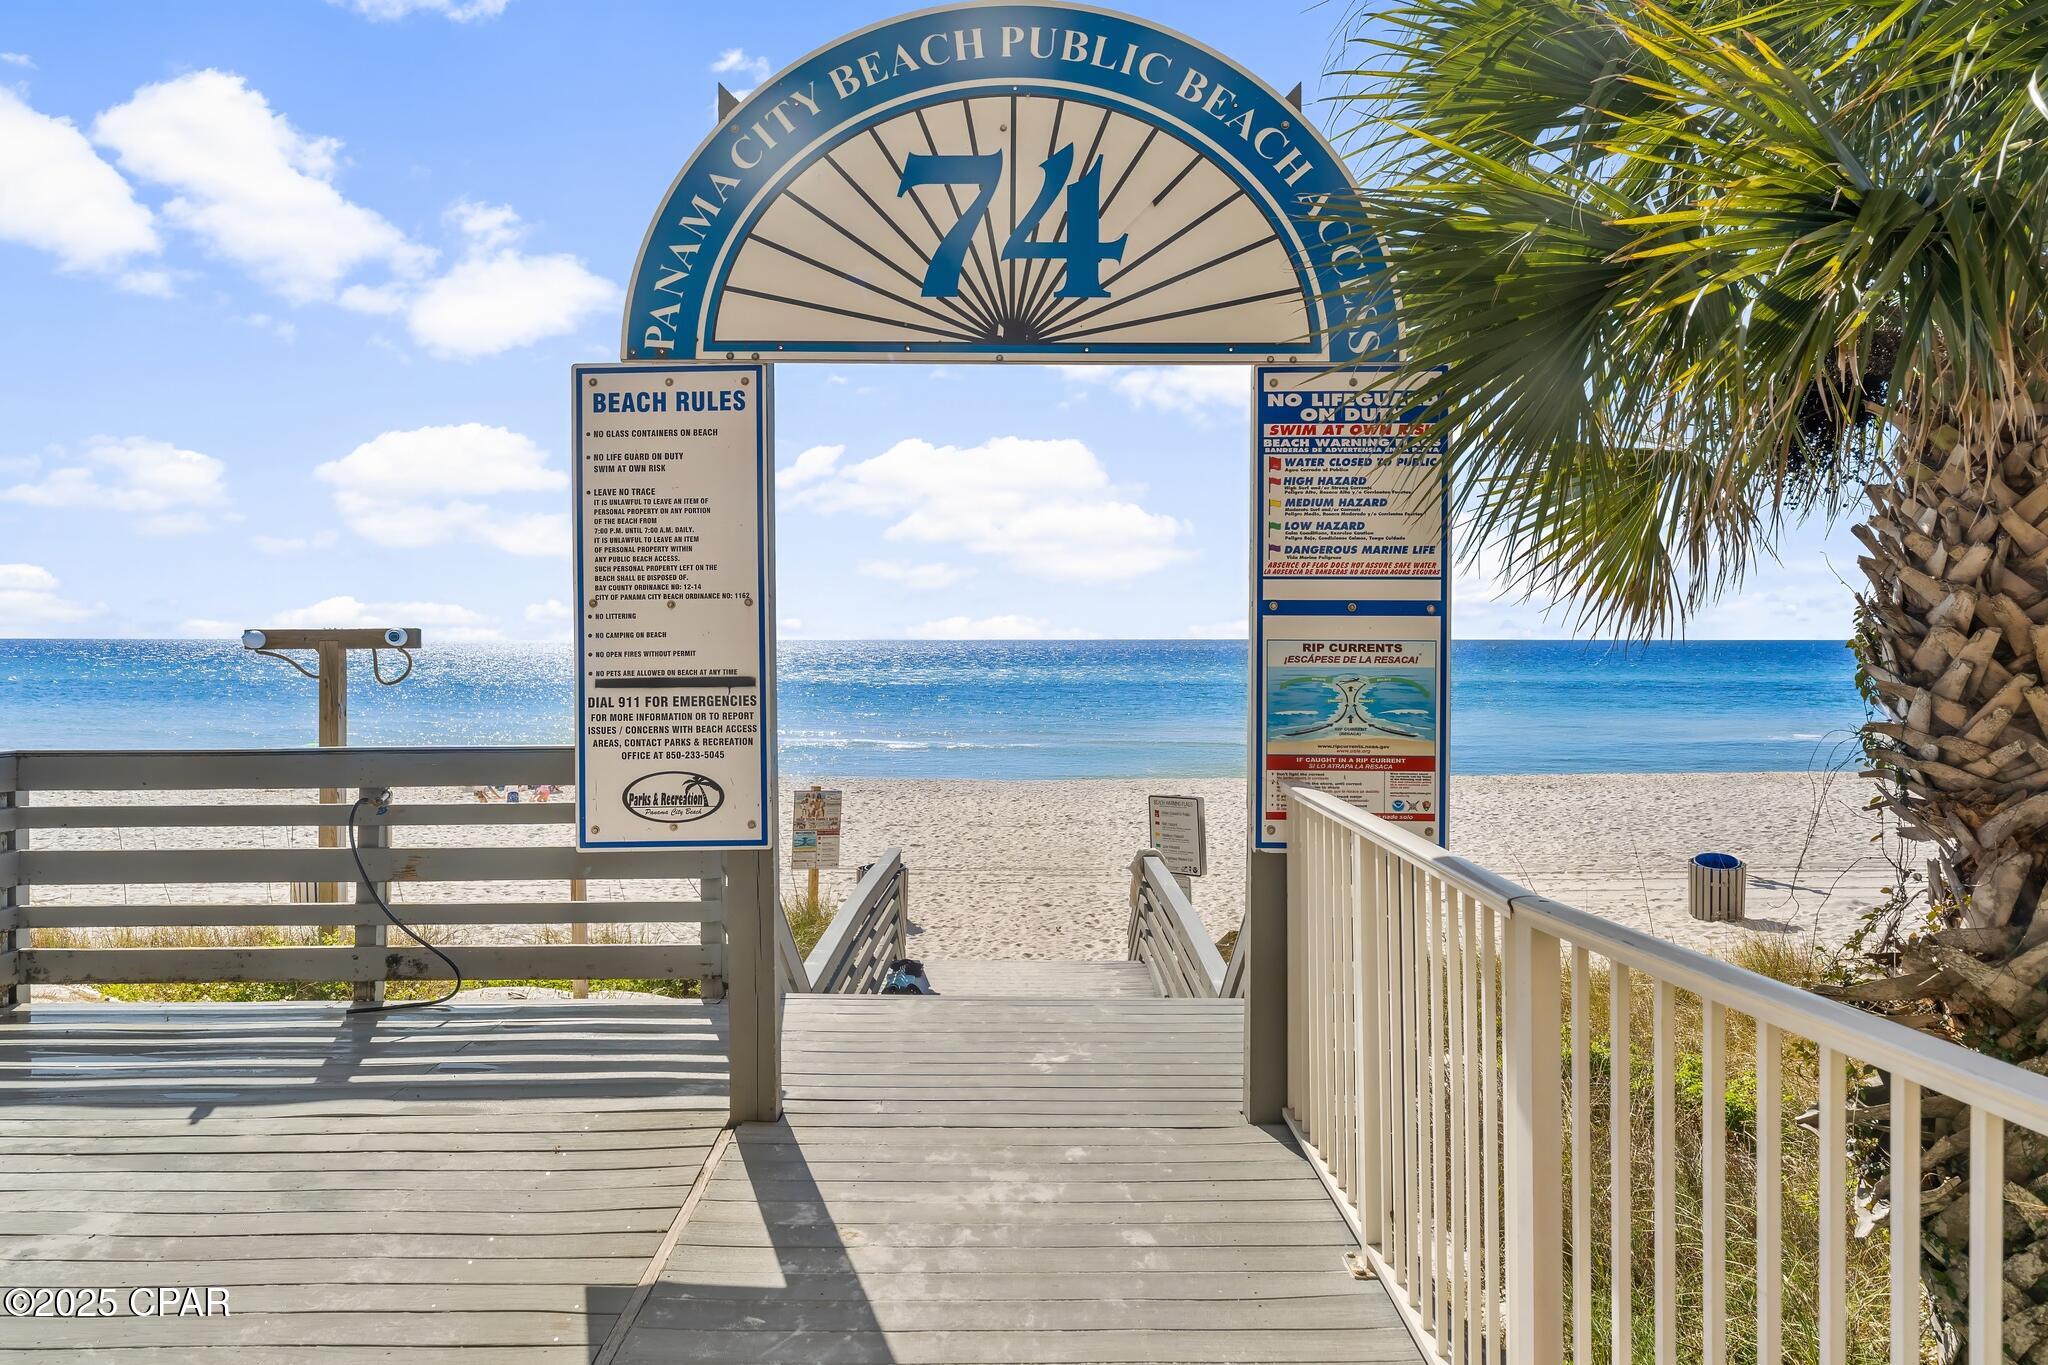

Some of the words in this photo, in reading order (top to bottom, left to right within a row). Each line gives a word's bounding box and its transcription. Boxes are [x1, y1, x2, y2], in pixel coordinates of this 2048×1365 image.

[644, 174, 741, 350] PANAMA
[731, 81, 822, 169] CITY
[828, 28, 985, 99] BEACH
[1000, 26, 1173, 85] PUBLIC
[1176, 67, 1314, 187] BEACH
[897, 142, 1129, 298] 74
[593, 392, 666, 412] BEACH
[676, 390, 745, 411] RULES
[1267, 393, 1302, 406] NO
[1300, 408, 1339, 421] ON
[1269, 425, 1317, 435] SWIM
[1323, 425, 1343, 434] AT
[1349, 425, 1391, 434] OWN
[1315, 439, 1390, 447] WARNING
[1285, 458, 1324, 466] WATER
[1329, 458, 1372, 466] CLOSED
[1396, 458, 1437, 466] PUBLIC
[1283, 477, 1313, 485] HIGH
[1317, 477, 1366, 485] HAZARD
[1284, 498, 1333, 506] MEDIUM
[1338, 498, 1387, 506] HAZARD
[1284, 522, 1312, 530] LOW
[1316, 522, 1364, 530] HAZARD
[1412, 546, 1435, 554] LIFE
[1303, 643, 1324, 652] RIP
[1329, 643, 1402, 652] CURRENTS
[1284, 654, 1340, 664] ¡ESCÁPESE
[588, 697, 614, 707] DIAL
[618, 696, 638, 707] 911
[645, 696, 667, 707] FOR
[673, 695, 756, 706] EMERGENCIES
[610, 713, 633, 721] MORE
[636, 713, 692, 721] INFORMATION
[588, 726, 616, 734] ISSUES
[619, 726, 622, 734] /
[625, 726, 668, 734] CONCERNS
[593, 739, 621, 747] AREAS,
[664, 738, 690, 746] PARKS
[622, 751, 650, 759] OFFICE
[666, 751, 724, 759] 850-233-5045
[629, 793, 650, 806] Parks
[653, 792, 658, 805] &
[661, 792, 703, 806] Recreation
[670, 808, 683, 816] City
[685, 808, 702, 816] Beach
